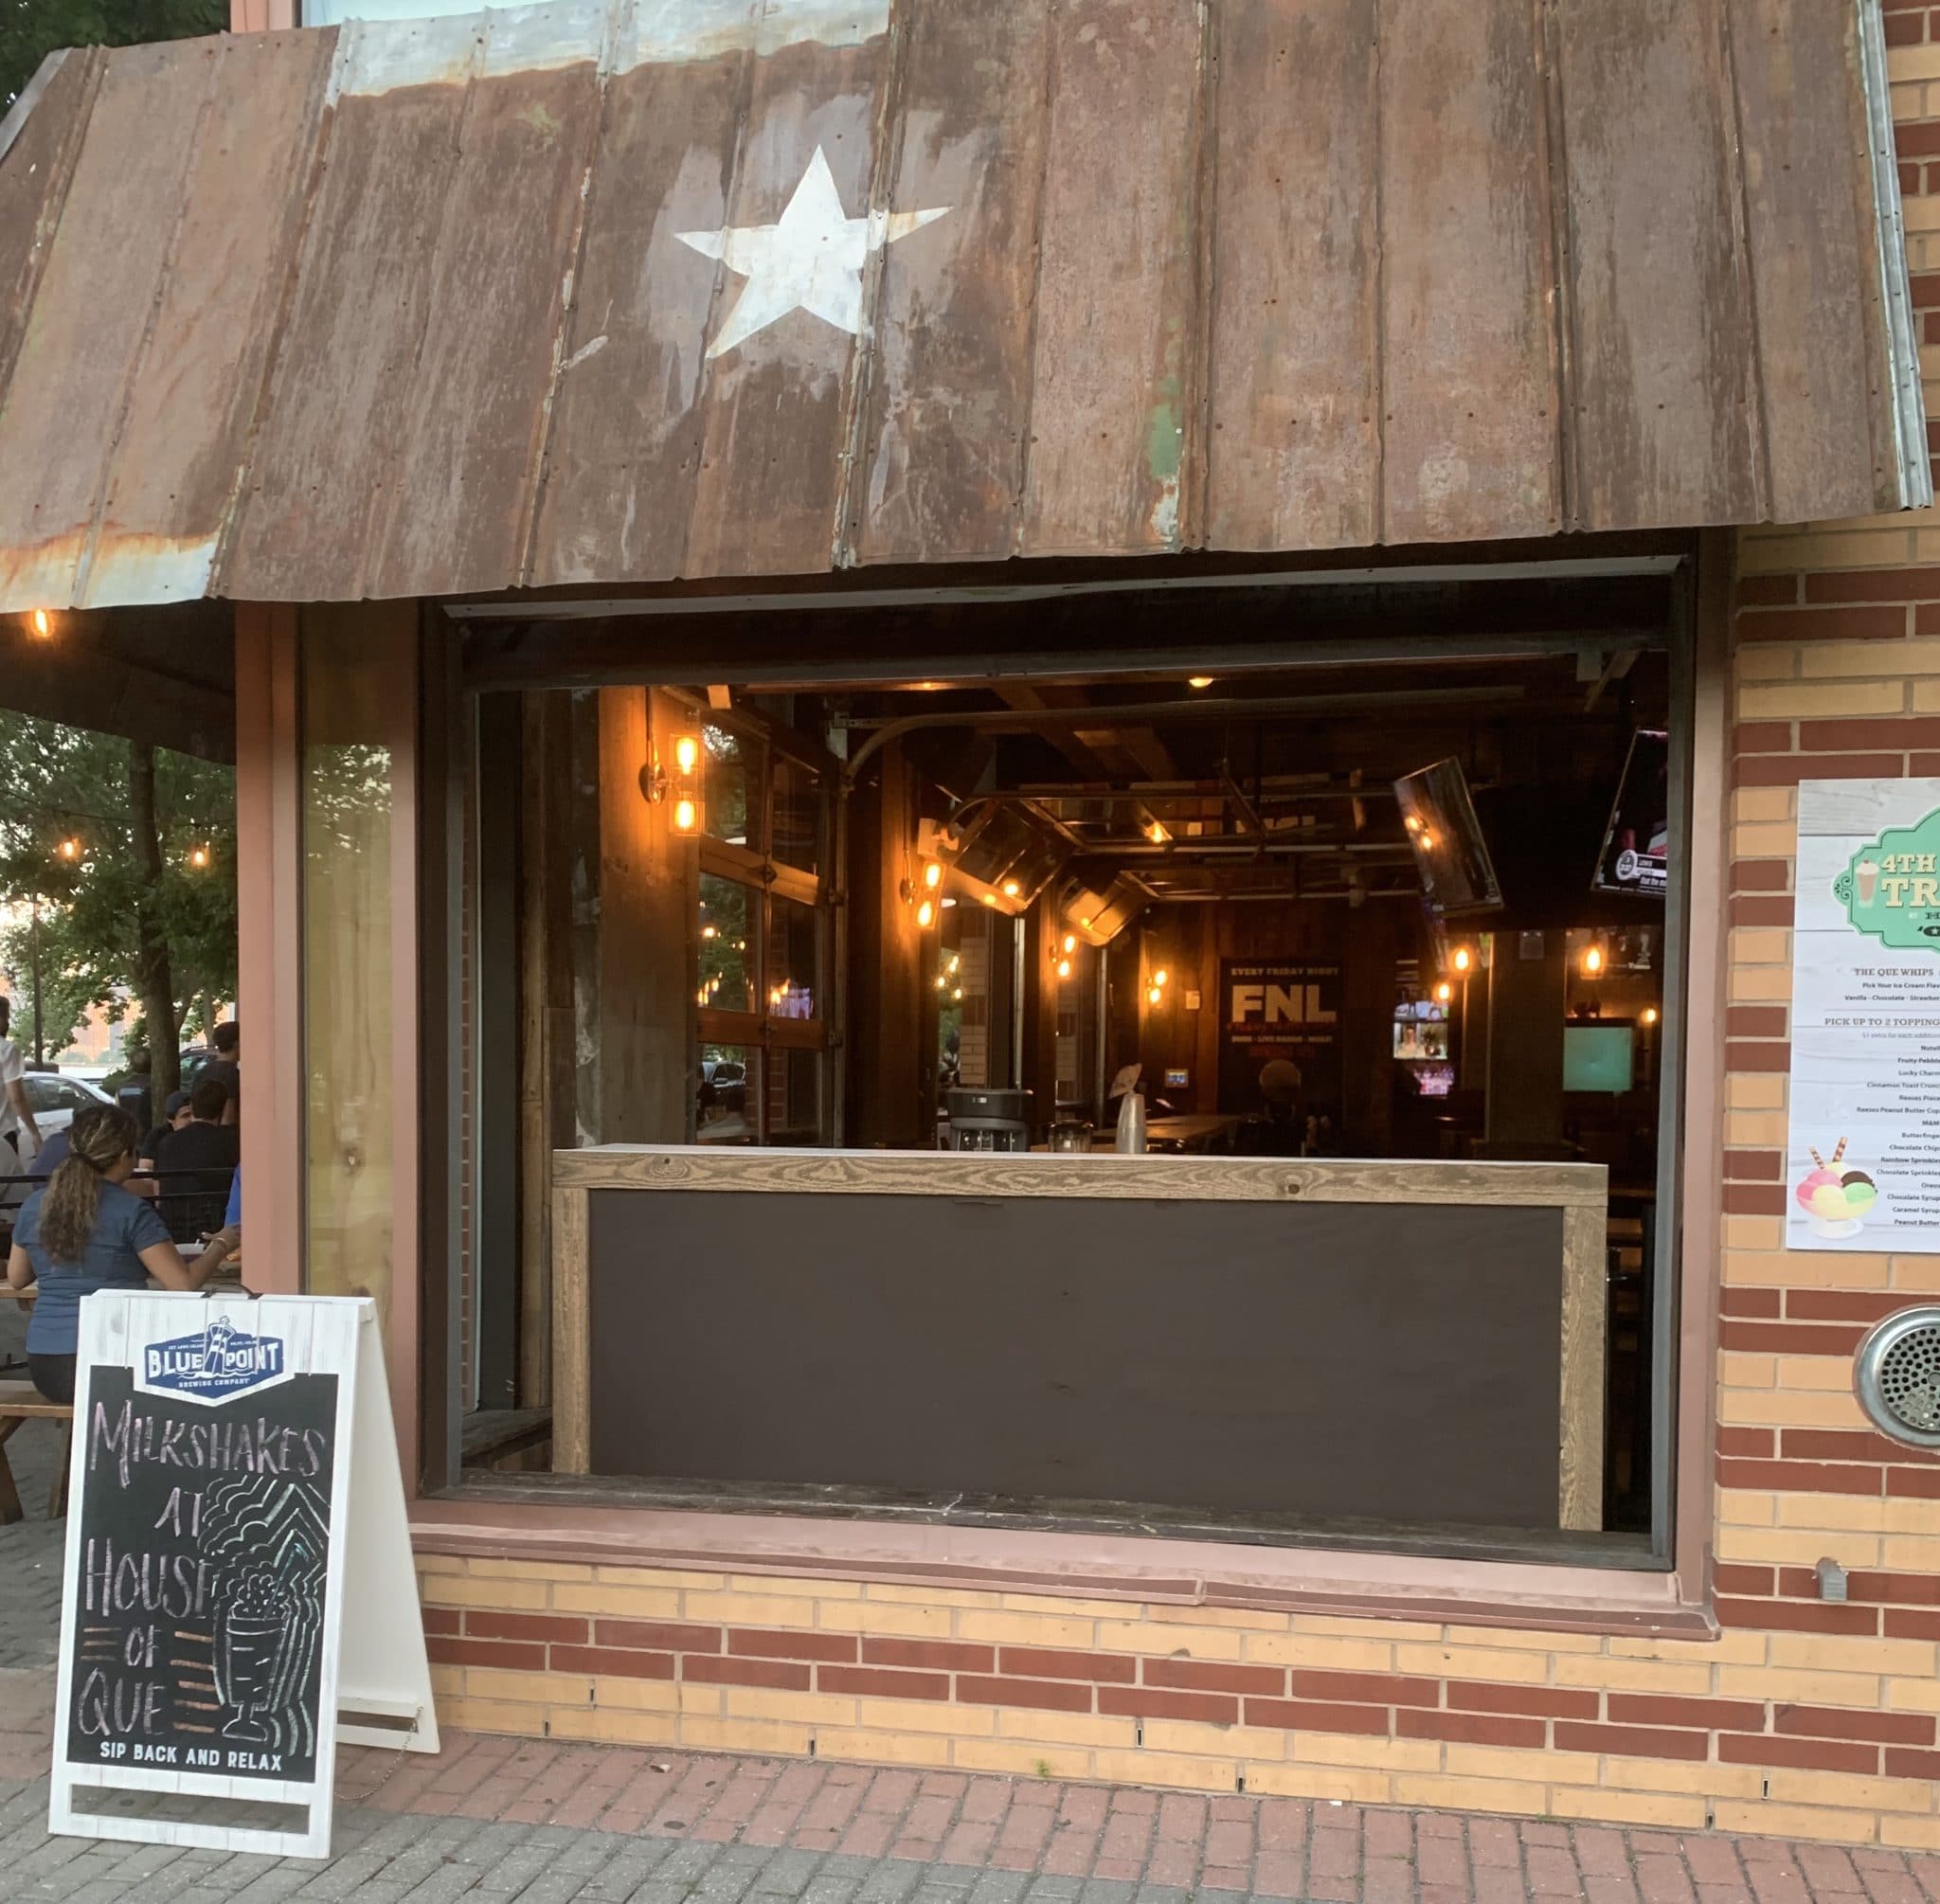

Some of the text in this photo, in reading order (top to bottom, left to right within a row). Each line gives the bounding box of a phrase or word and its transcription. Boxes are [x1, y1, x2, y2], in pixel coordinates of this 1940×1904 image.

[1881, 854, 1937, 874] 4TH
[1854, 968, 1934, 977] THE QUE WHIPS
[1232, 985, 1337, 1023] FNL
[148, 1342, 279, 1378] BLUE POINT
[178, 1377, 250, 1388] BREWING COMPANY
[90, 1399, 327, 1489] MILKSHAKES
[154, 1486, 205, 1537] AT
[86, 1537, 214, 1619] HOUSE
[125, 1624, 163, 1668] OF
[79, 1667, 167, 1736] QUE
[99, 1741, 282, 1771] SIP BACK AND RELAX
